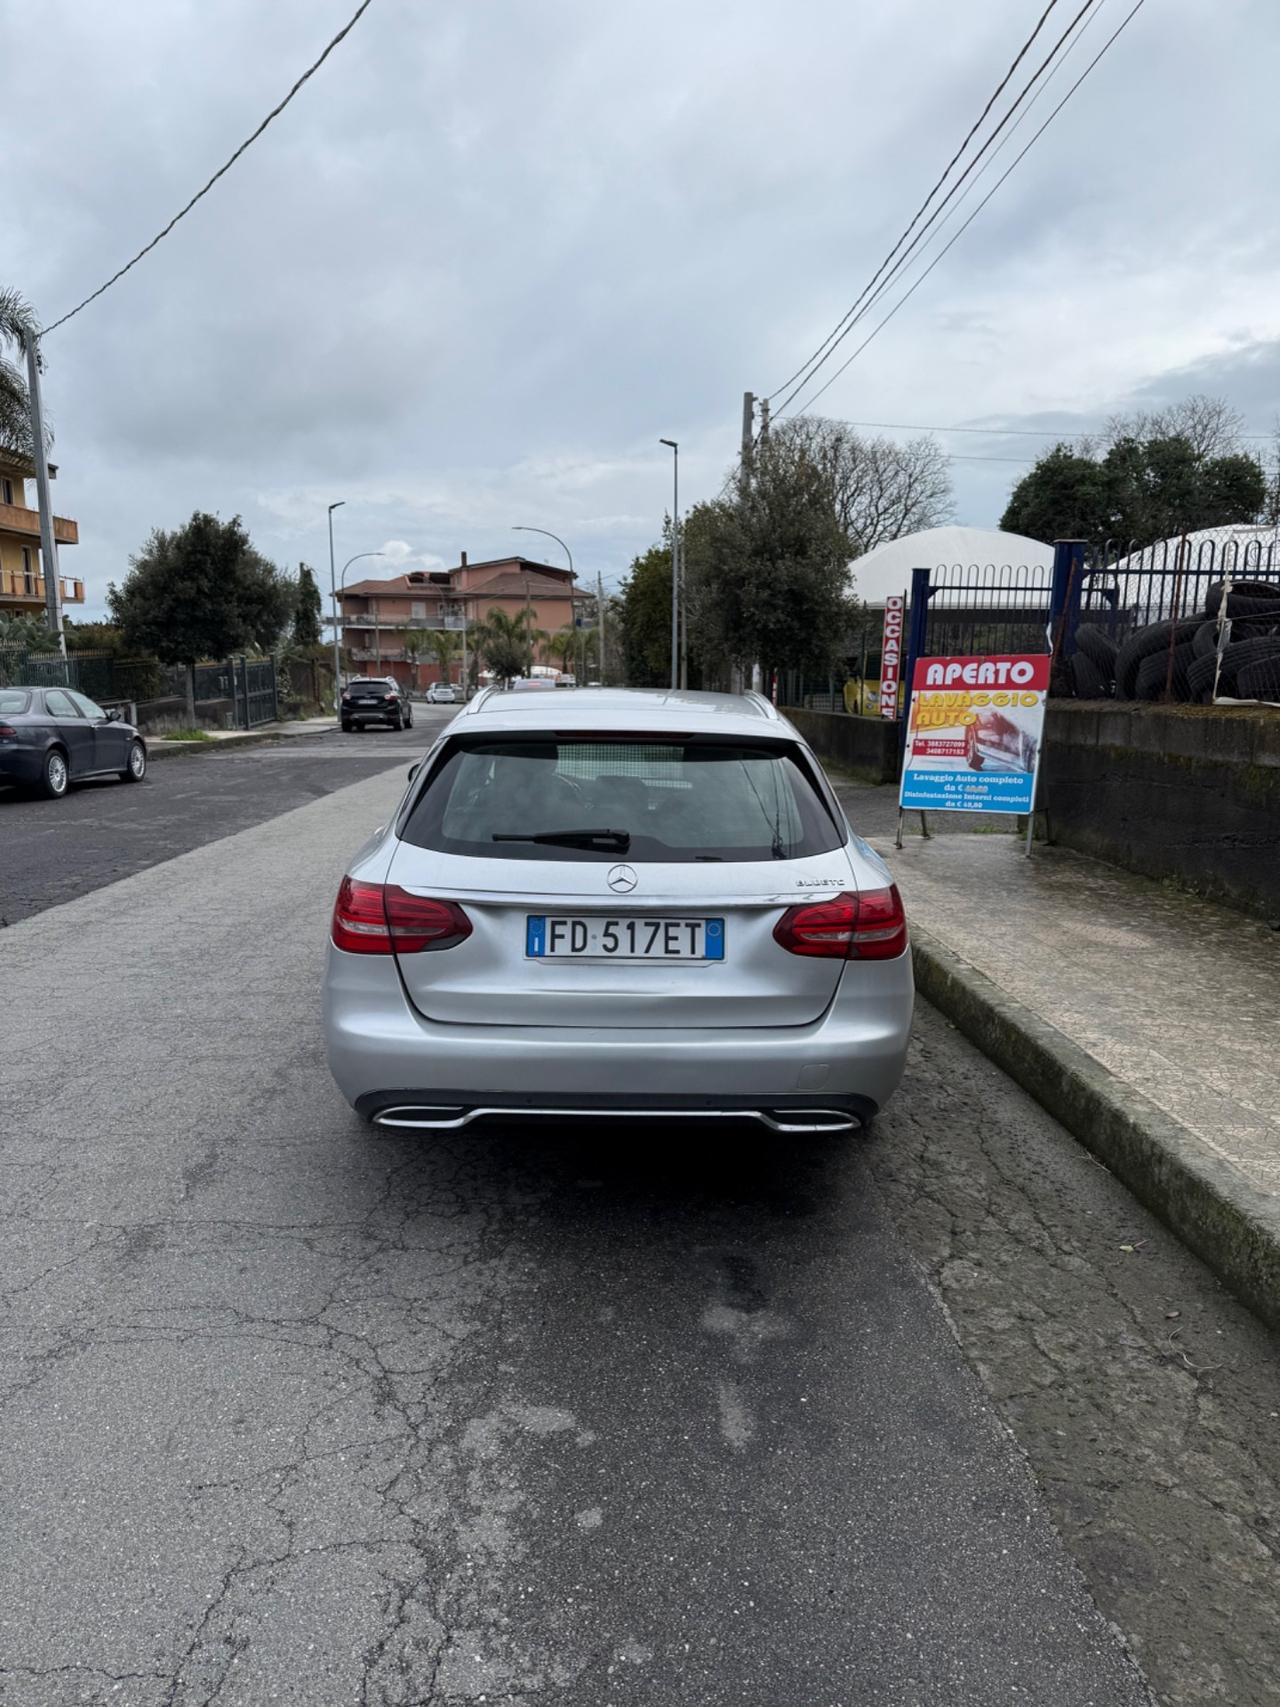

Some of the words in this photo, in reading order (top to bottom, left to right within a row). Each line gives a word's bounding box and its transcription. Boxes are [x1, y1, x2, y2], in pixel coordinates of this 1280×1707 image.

[882, 597, 902, 719] OCCASIONE
[926, 661, 1034, 685] APERTO
[918, 692, 1039, 707] LAVAGGIO
[916, 711, 977, 726] AUTO
[913, 773, 954, 783] Lavaggio
[955, 774, 977, 782] Auto
[979, 776, 1024, 785] completo
[963, 793, 992, 801] Interni
[993, 795, 1029, 803] completi
[550, 920, 588, 953] FD
[602, 920, 702, 955] 517ET
